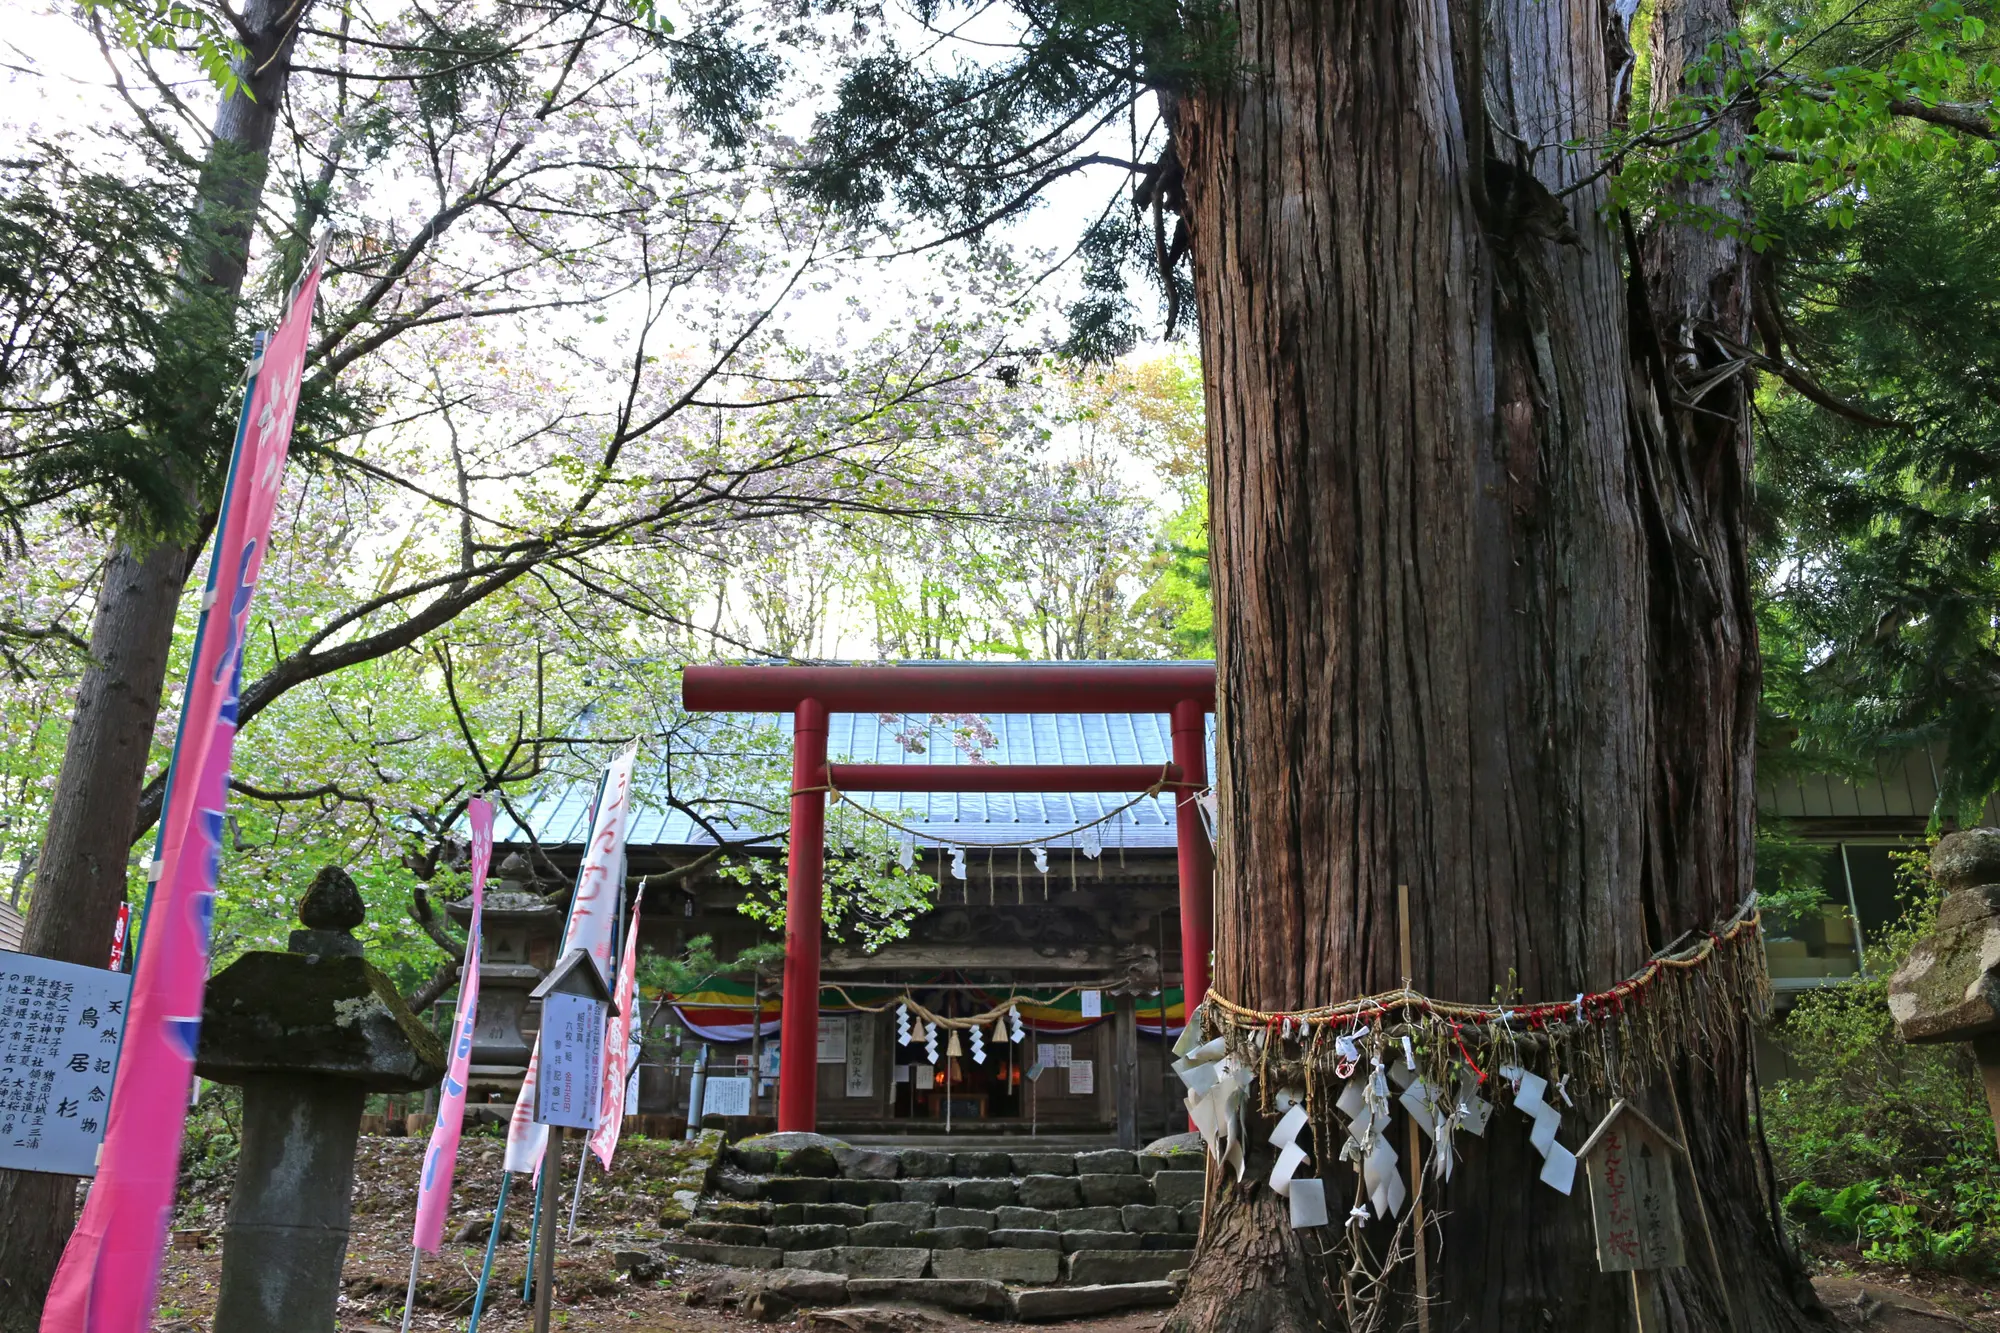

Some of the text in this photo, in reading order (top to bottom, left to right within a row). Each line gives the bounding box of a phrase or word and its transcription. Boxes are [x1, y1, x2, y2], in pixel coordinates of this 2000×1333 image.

[18, 976, 49, 1067] 年後の承元元年夏
[26, 983, 75, 1150] 元久二年甲子年 猪苗代城主三浦
[56, 1006, 101, 1119] 鳥居杉
[79, 1000, 124, 1134] 天然記念物
[13, 1139, 25, 1148] 二
